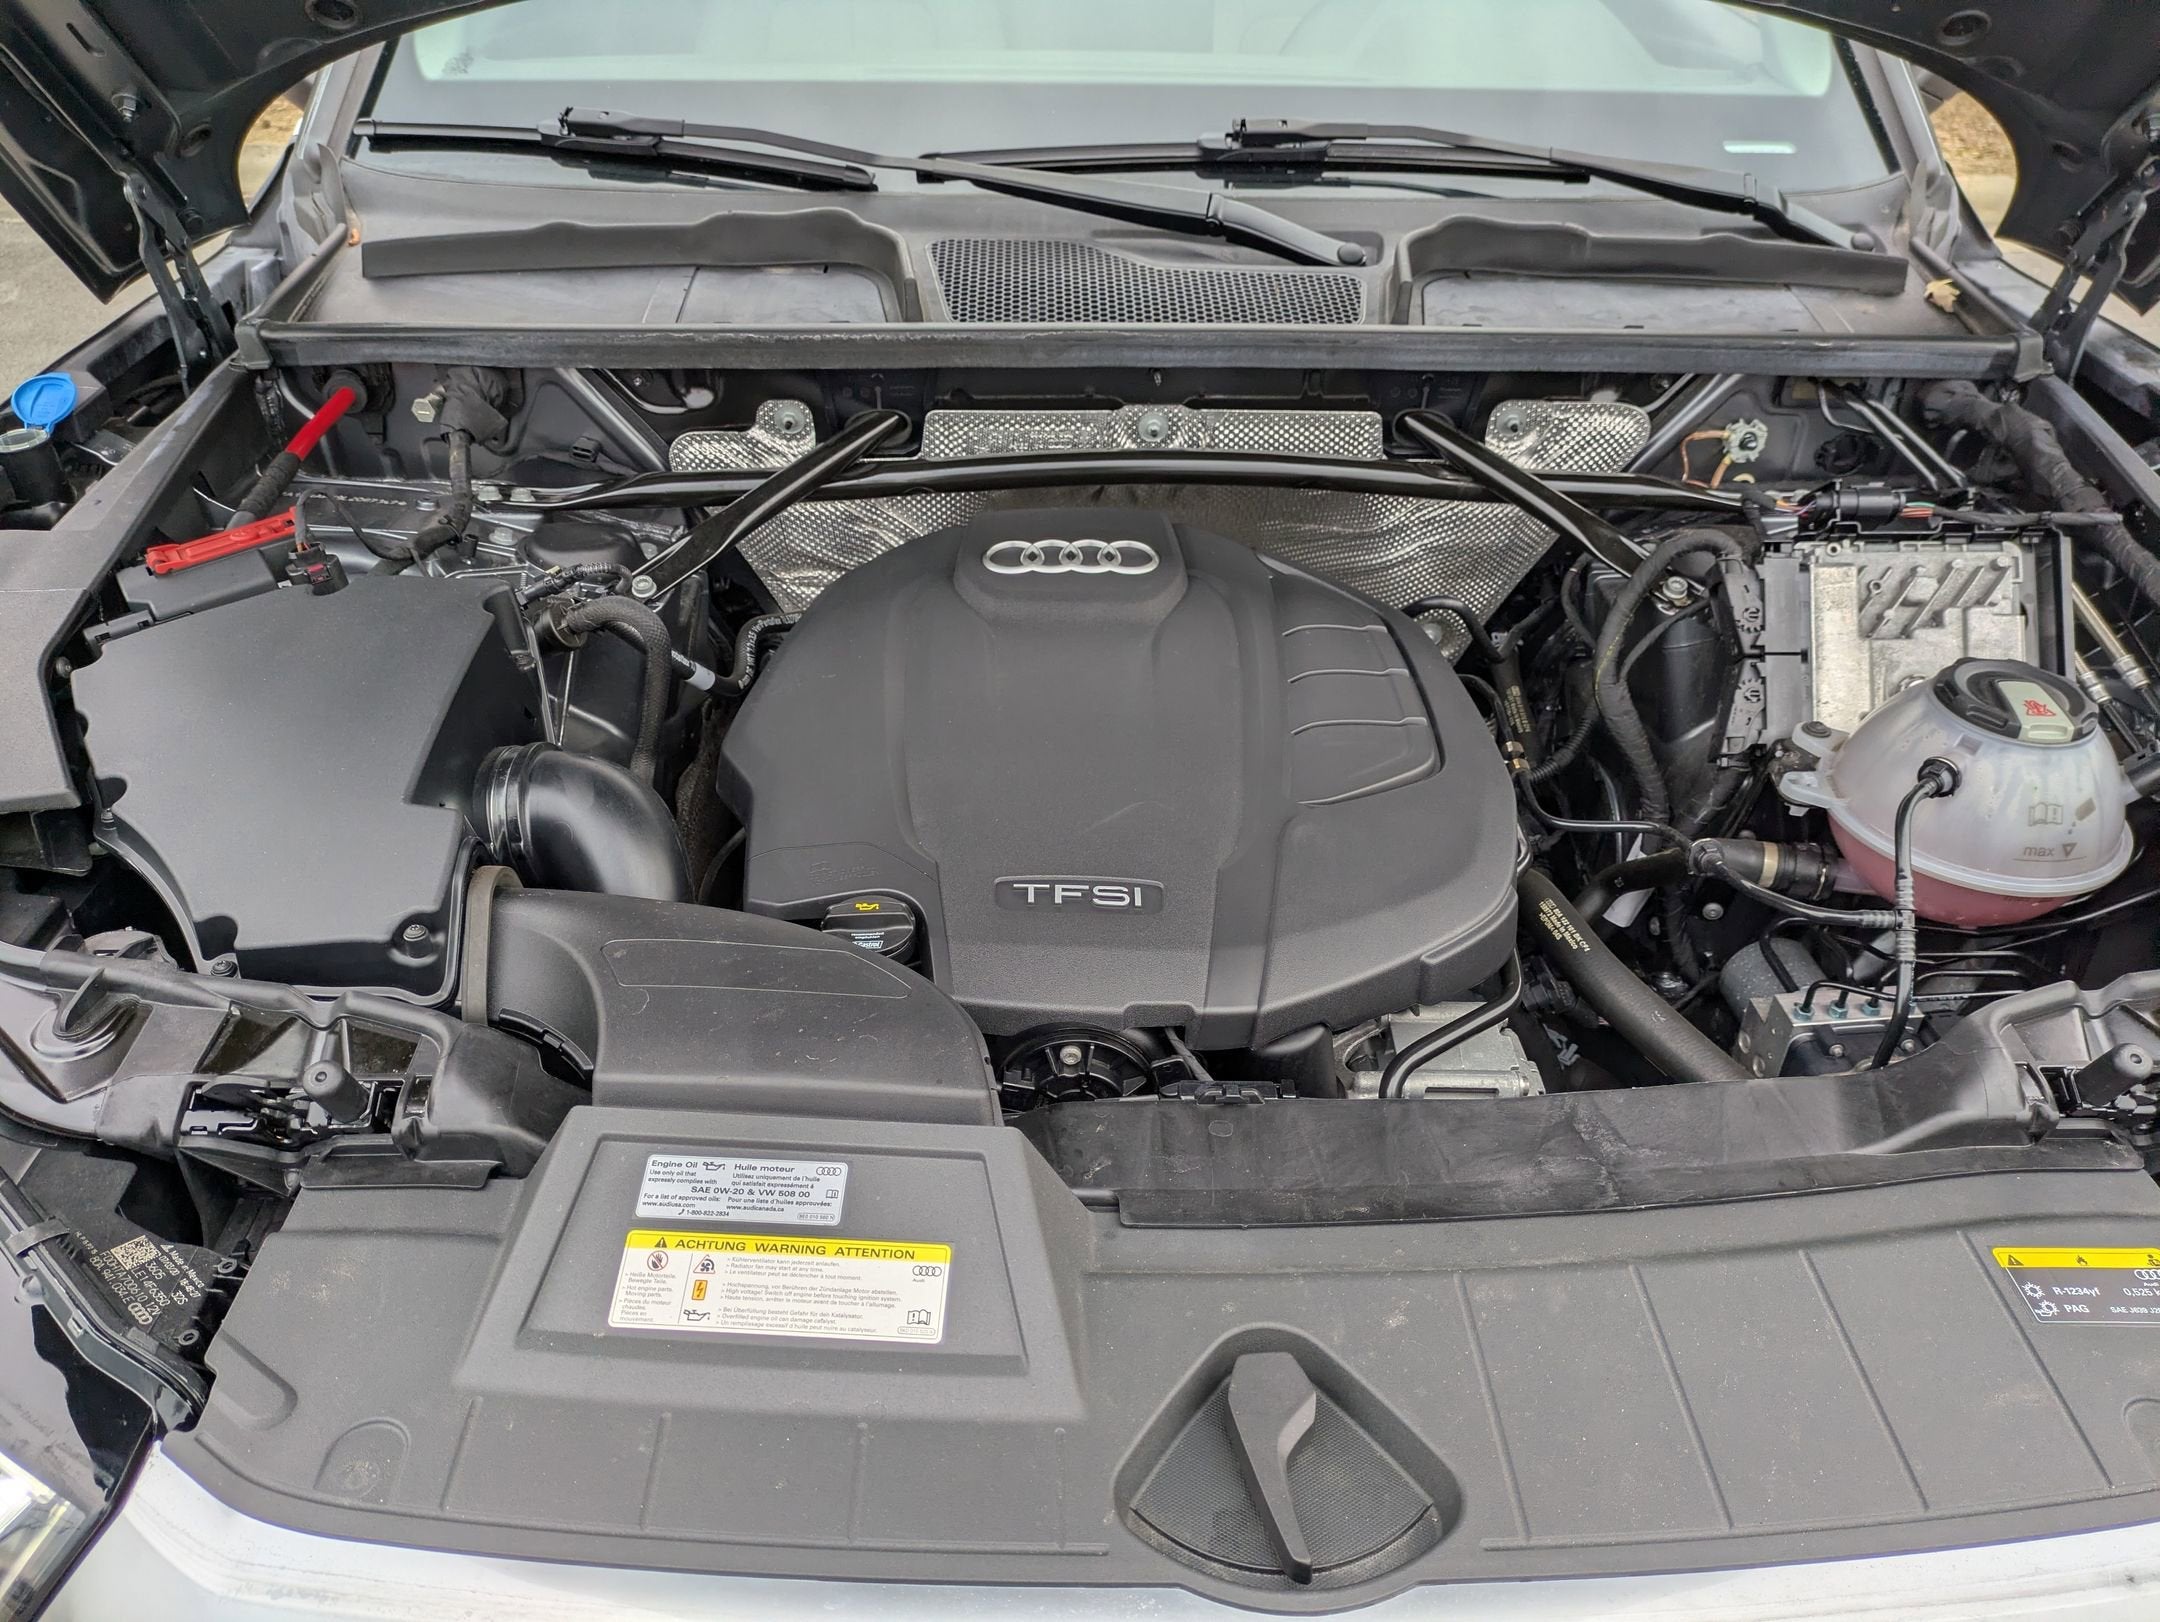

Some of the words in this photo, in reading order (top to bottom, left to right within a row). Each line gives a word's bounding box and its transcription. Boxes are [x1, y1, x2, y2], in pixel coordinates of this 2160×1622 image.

[2024, 846, 2055, 856] max
[1013, 883, 1142, 908] TFSI
[1550, 914, 1561, 927] Made
[1563, 931, 1578, 949] Mexico
[651, 1160, 683, 1169] Engine
[733, 1163, 758, 1171] Huile
[760, 1165, 796, 1173] moteur
[676, 1177, 704, 1185] complies
[713, 1187, 745, 1195] 0W-20
[642, 1200, 696, 1208] www.audiusa.com
[726, 1204, 785, 1212] www.audicanada.ca
[674, 1238, 747, 1252] ACHTUNG
[753, 1242, 827, 1255] WARNING
[834, 1246, 915, 1260] ATTENTION
[146, 1262, 165, 1279] 3605
[170, 1250, 184, 1265] Made
[186, 1269, 204, 1288] Mexico
[2052, 1286, 2100, 1297] R-1234yf
[2122, 1288, 2154, 1296] 0,525
[146, 1301, 161, 1316] 12V
[2064, 1304, 2090, 1313] PAG
